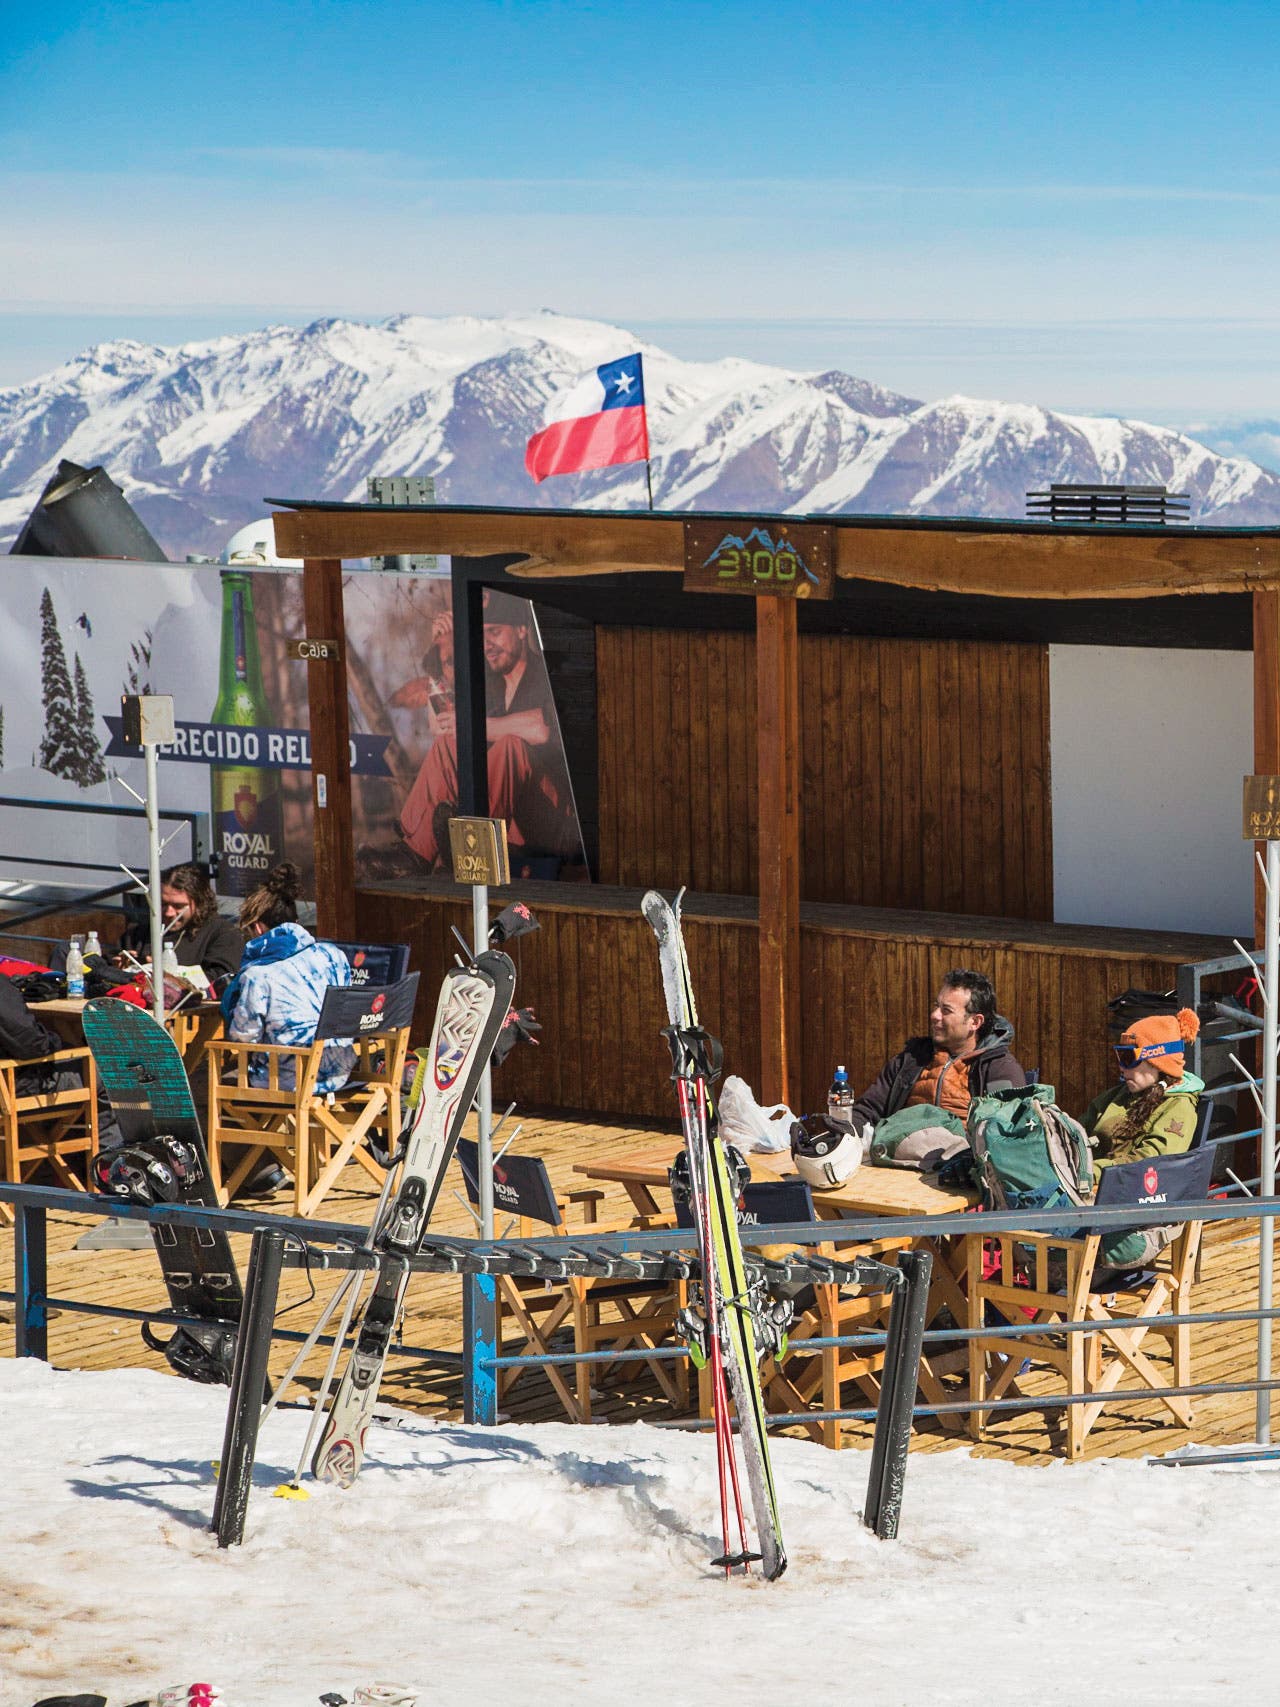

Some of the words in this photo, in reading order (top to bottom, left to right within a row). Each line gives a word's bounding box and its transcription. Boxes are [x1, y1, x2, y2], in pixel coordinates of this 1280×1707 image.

[297, 641, 328, 659] Caja
[139, 727, 259, 761] RECIDO
[222, 831, 275, 856] ROYAL
[227, 855, 270, 870] GUARD
[456, 854, 490, 872] ROYAL
[461, 871, 488, 881] GUARD
[351, 968, 370, 980] OYAL
[359, 1012, 384, 1025] ROYAL
[736, 1211, 760, 1226] OYAL
